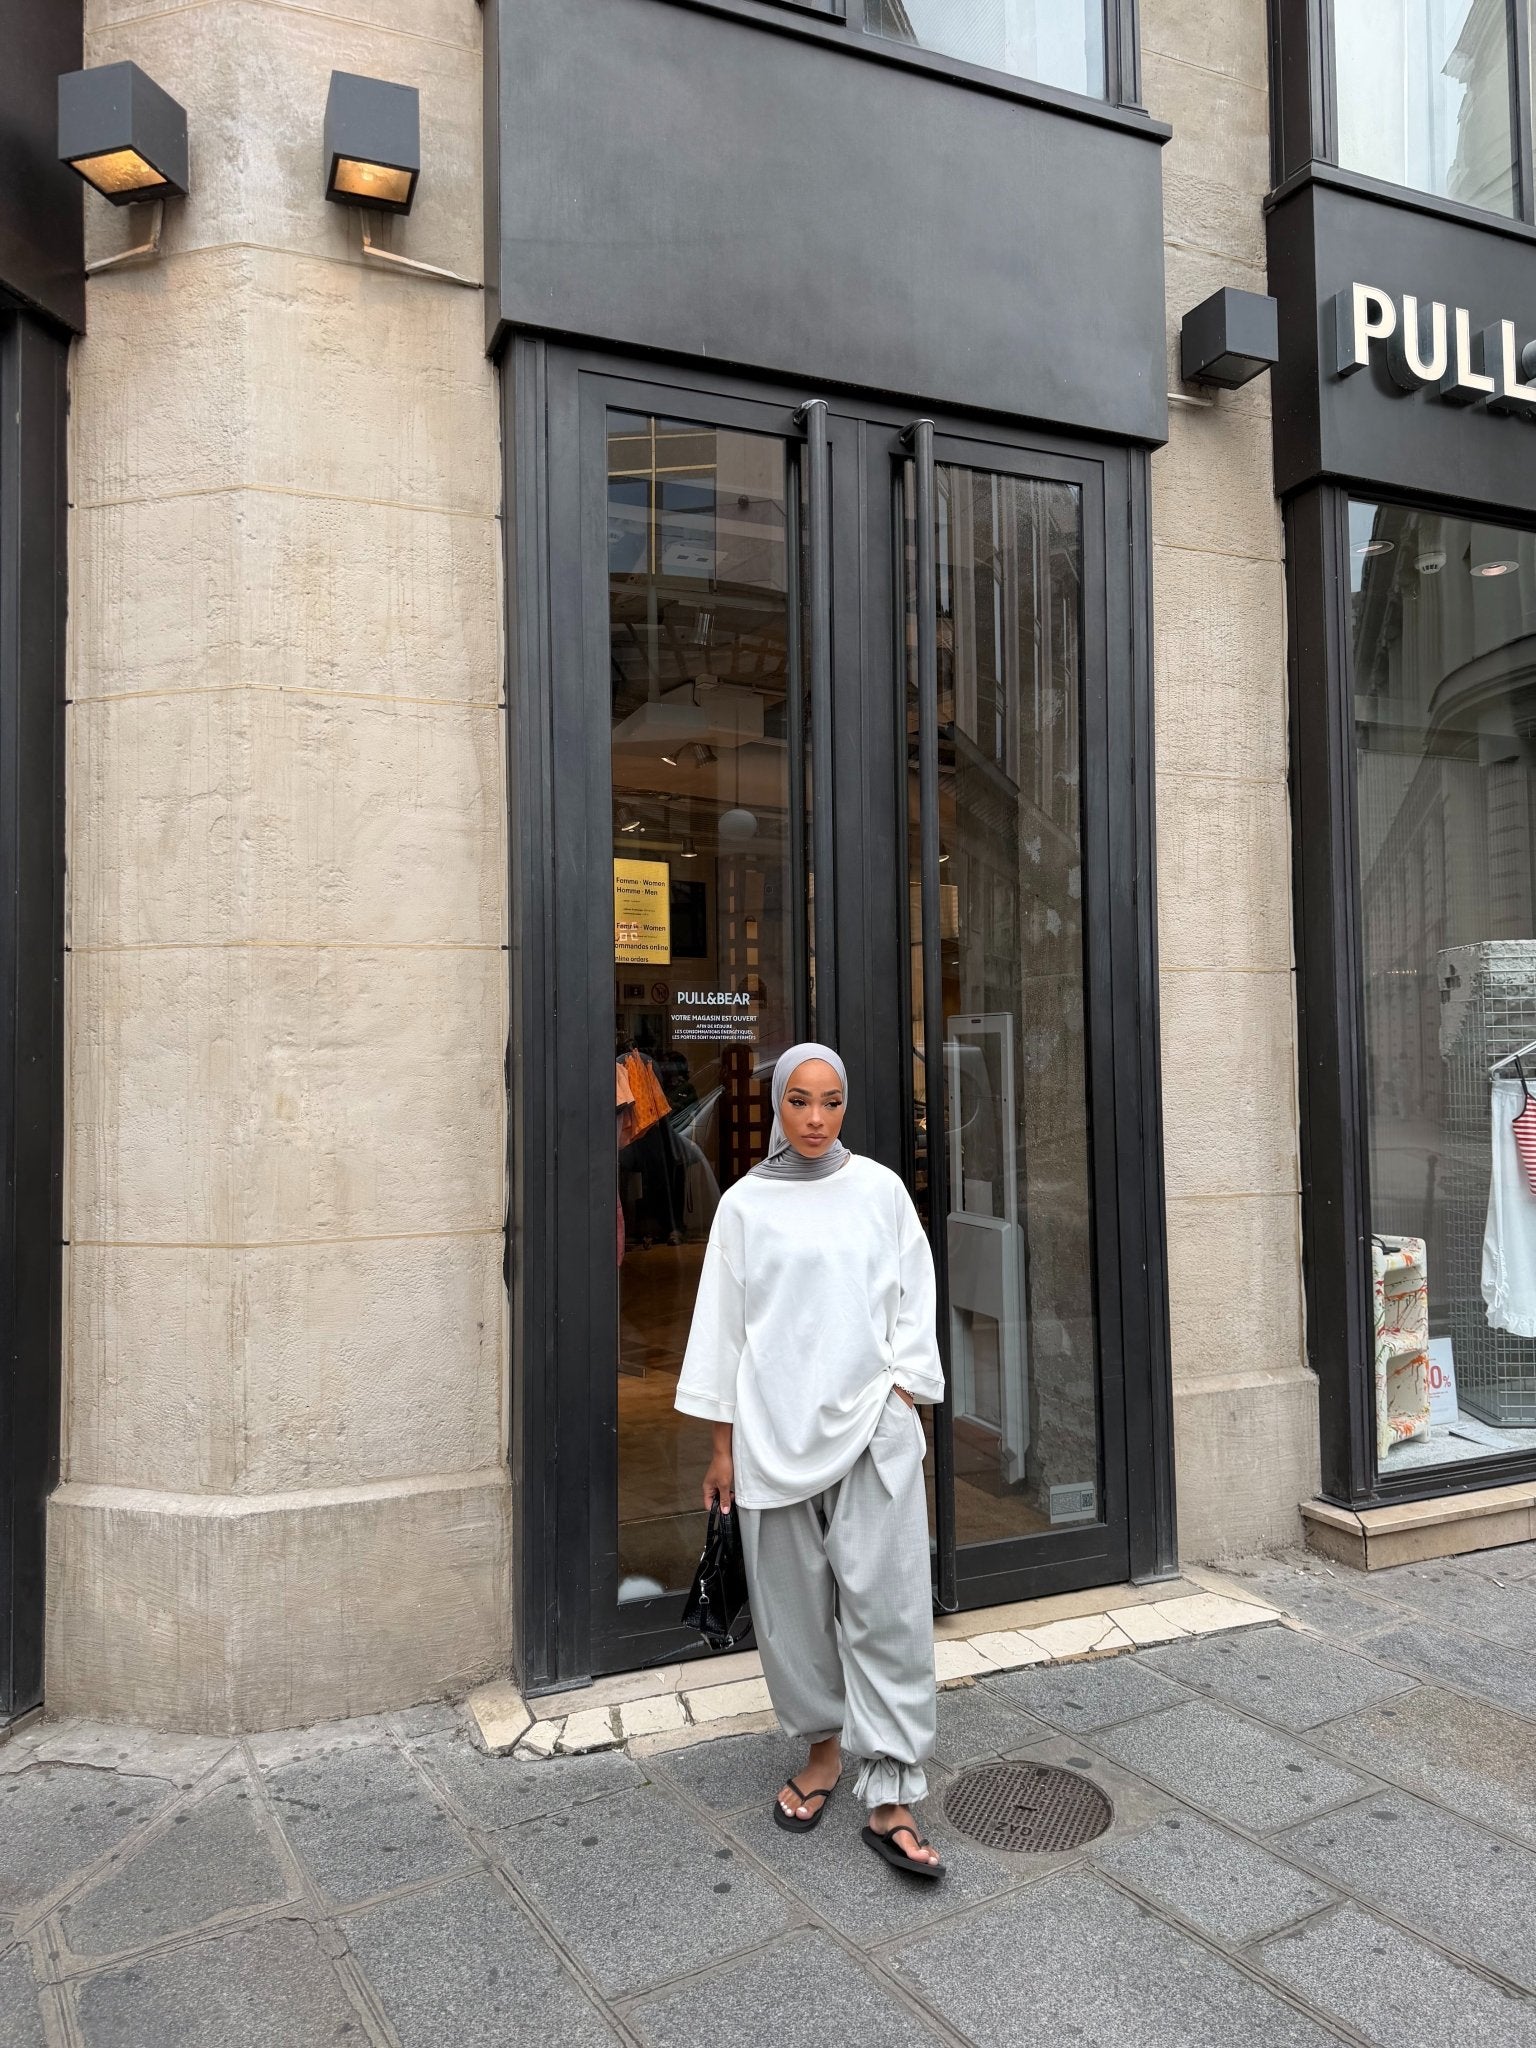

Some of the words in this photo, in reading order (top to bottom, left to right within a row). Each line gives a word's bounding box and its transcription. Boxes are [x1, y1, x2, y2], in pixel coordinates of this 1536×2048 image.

[1352, 282, 1536, 402] PULL
[616, 877, 639, 885] Femme
[643, 879, 666, 887] Women
[616, 887, 641, 895] Homme
[644, 888, 658, 896] Men
[677, 991, 750, 1005] PULL&BEAR
[1429, 1365, 1452, 1389] 0%
[994, 1821, 1033, 1836] GAZ
